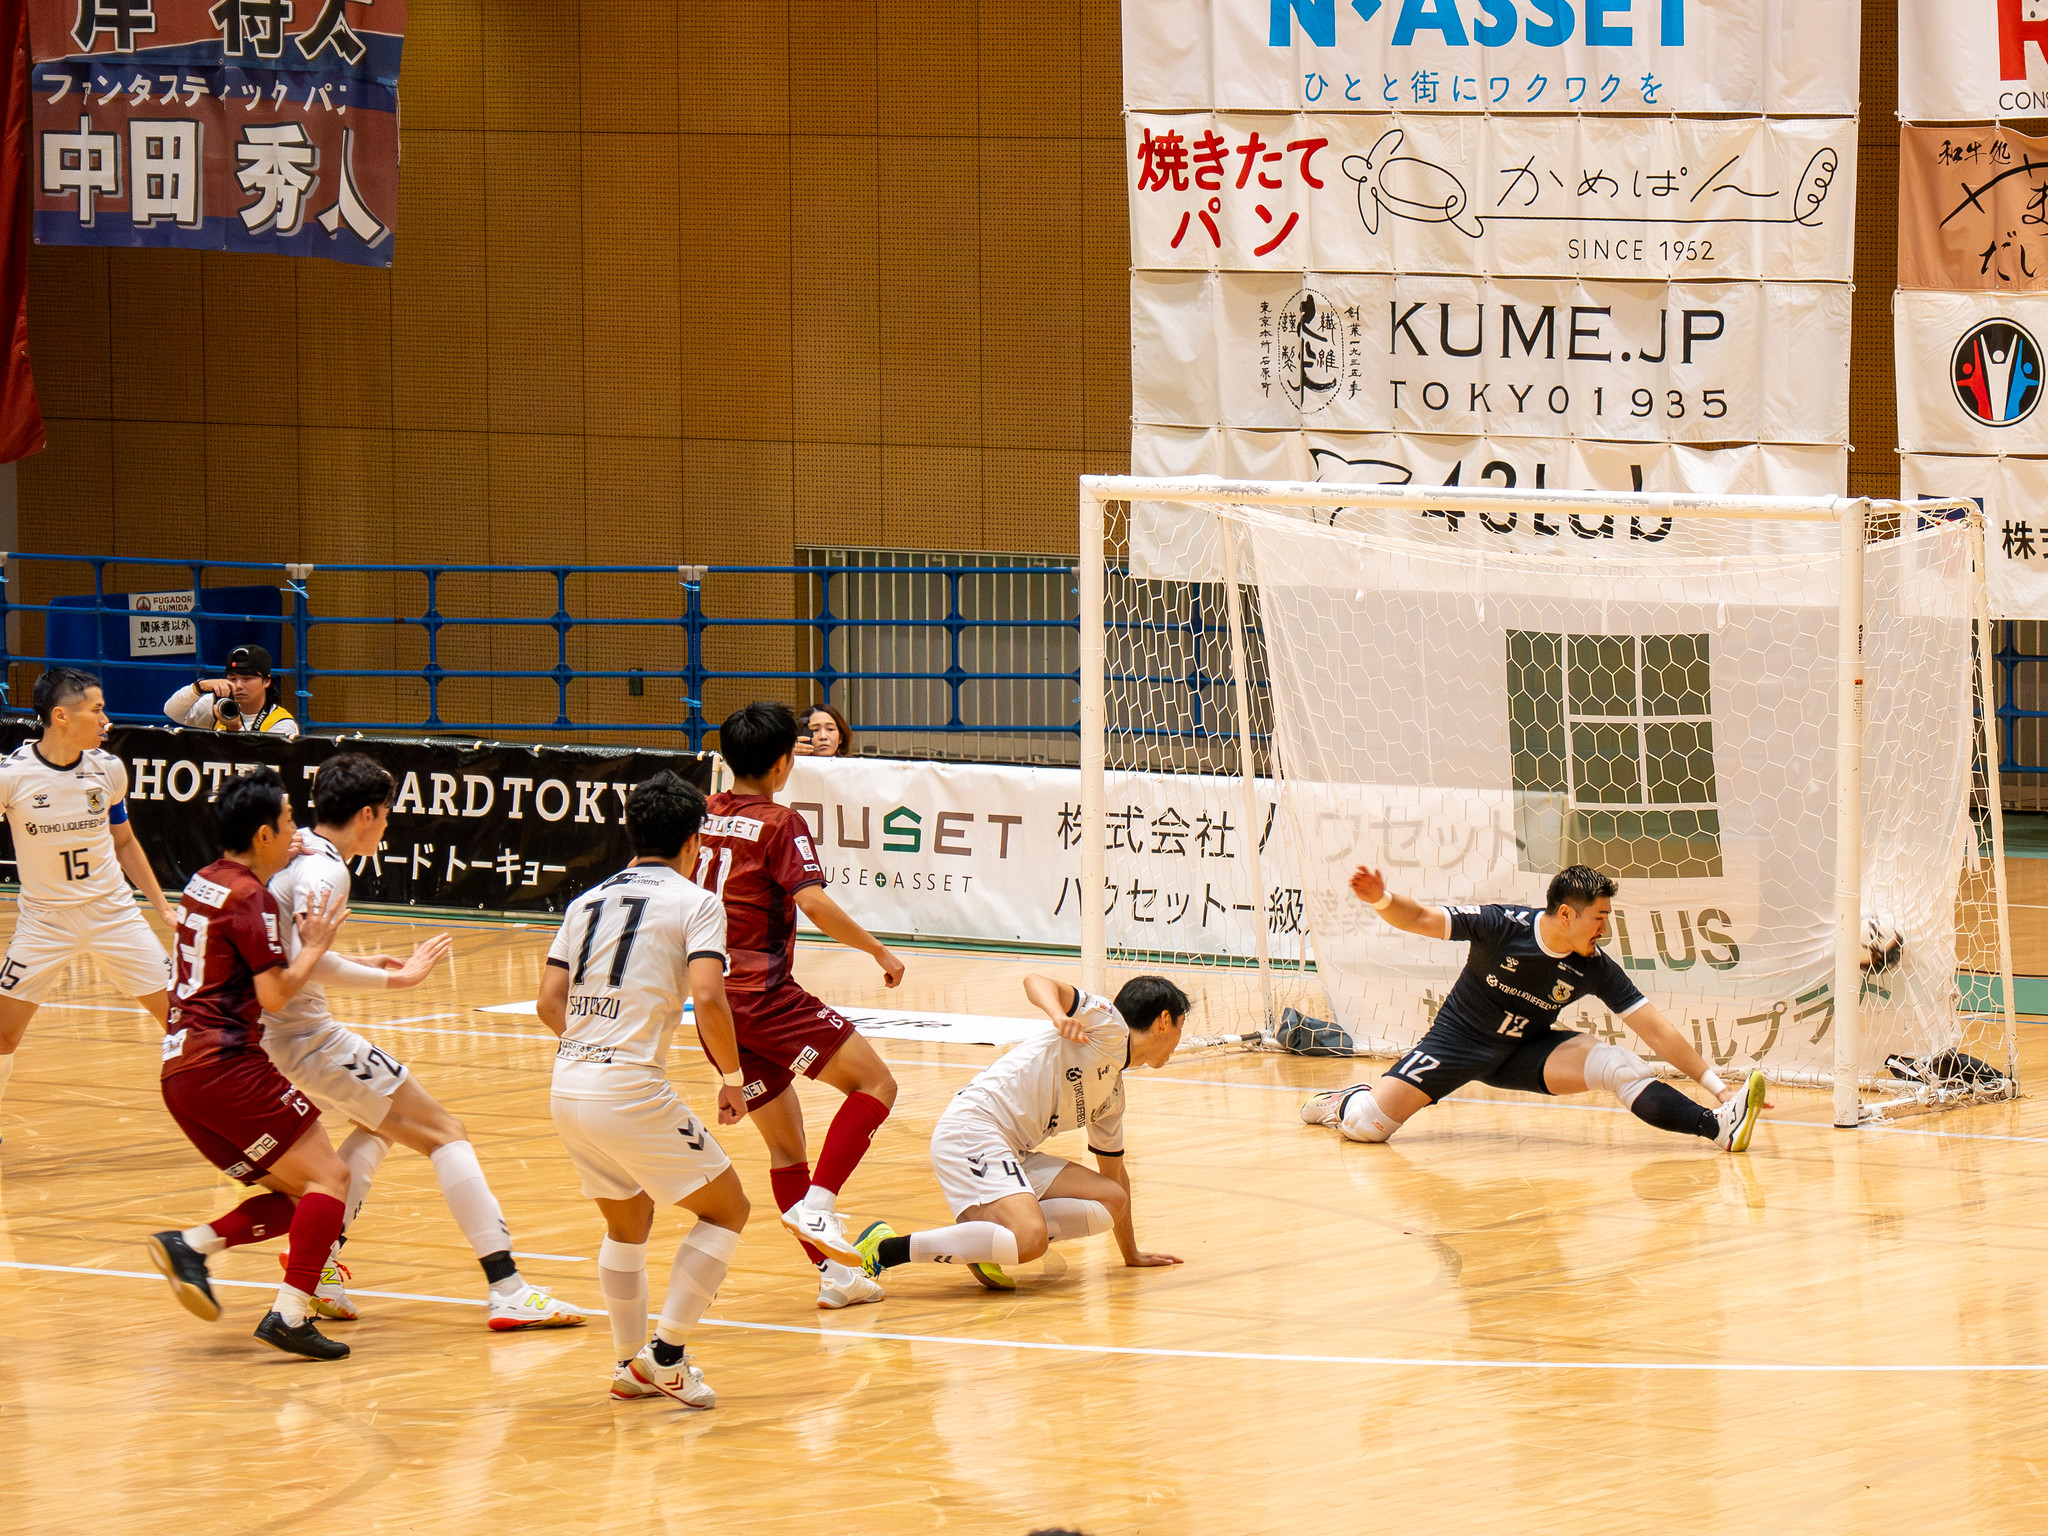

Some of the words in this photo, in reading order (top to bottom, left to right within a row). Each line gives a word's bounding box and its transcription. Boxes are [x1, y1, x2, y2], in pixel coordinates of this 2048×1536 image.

[1304, 70, 1663, 104] ひとと街にワクワクを
[1998, 91, 2048, 111] CON
[1137, 127, 1329, 192] 焼きたて
[1497, 155, 1779, 206] かめぱん
[1170, 196, 1300, 257] パン
[1568, 238, 1643, 260] SINCE
[1659, 240, 1715, 261] 1952
[1389, 300, 1726, 364] KUME.JP
[2002, 520, 2048, 559] 株
[153, 595, 193, 605] FUGADOR
[138, 633, 194, 648] 立ち入り禁止
[140, 620, 191, 633] 関係者以外
[254, 709, 267, 729] SONY
[39, 823, 61, 833] TOHO
[59, 848, 91, 881] 15
[572, 896, 650, 989] 11
[1496, 1010, 1530, 1038] 12
[1398, 1050, 1441, 1084] 12
[1002, 1160, 1027, 1187] 4
